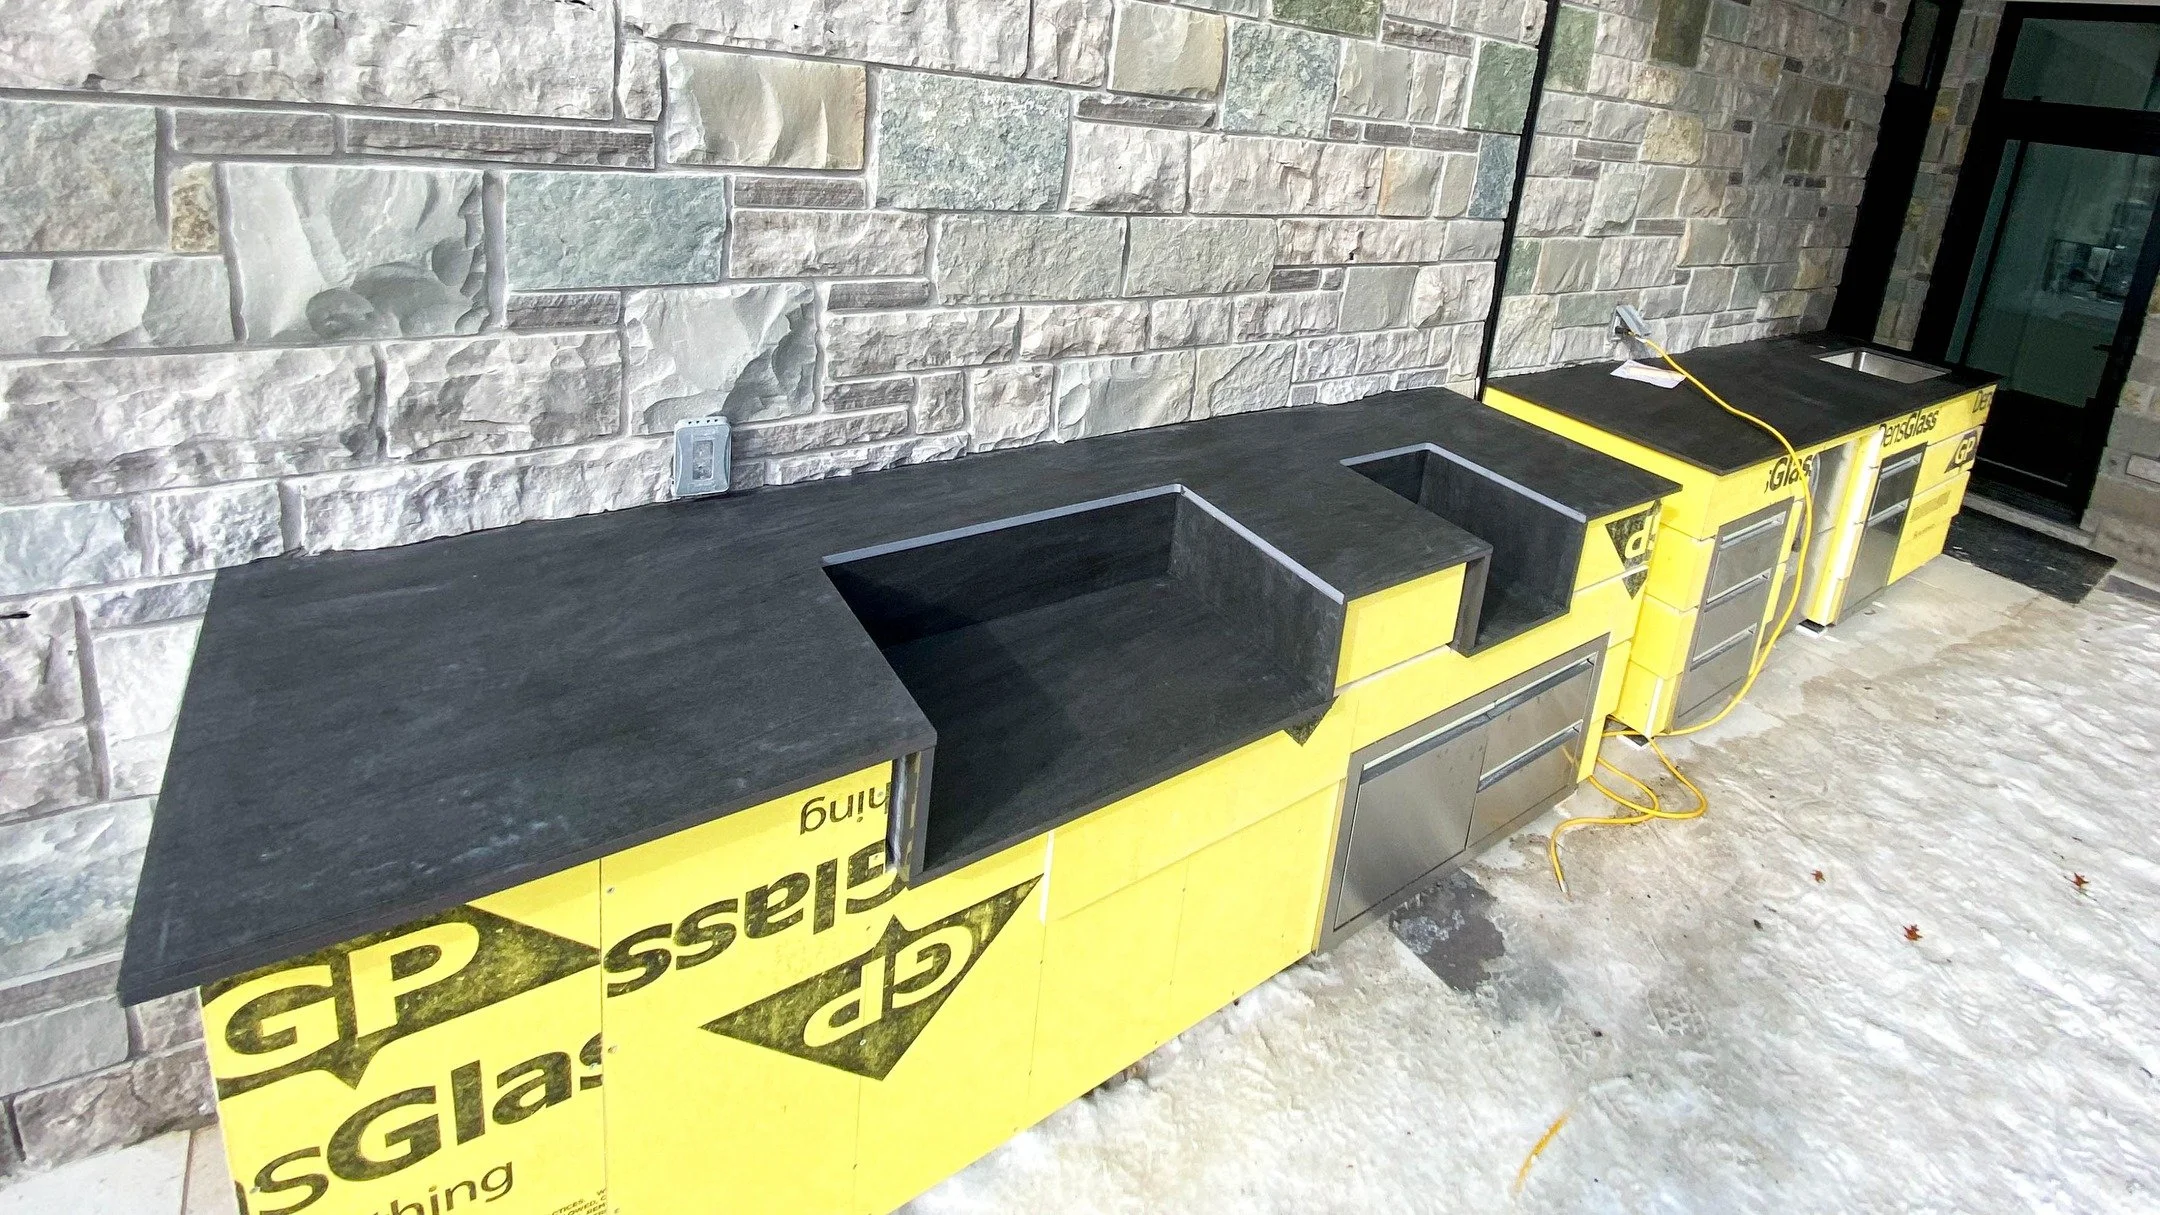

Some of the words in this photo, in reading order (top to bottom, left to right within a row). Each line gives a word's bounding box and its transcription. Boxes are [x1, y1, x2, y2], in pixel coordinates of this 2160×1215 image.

[1955, 436, 1977, 464] GP
[603, 838, 905, 998] Glass
[203, 922, 480, 1078] GP
[803, 926, 973, 1047] GP
[371, 1161, 513, 1215] hing
